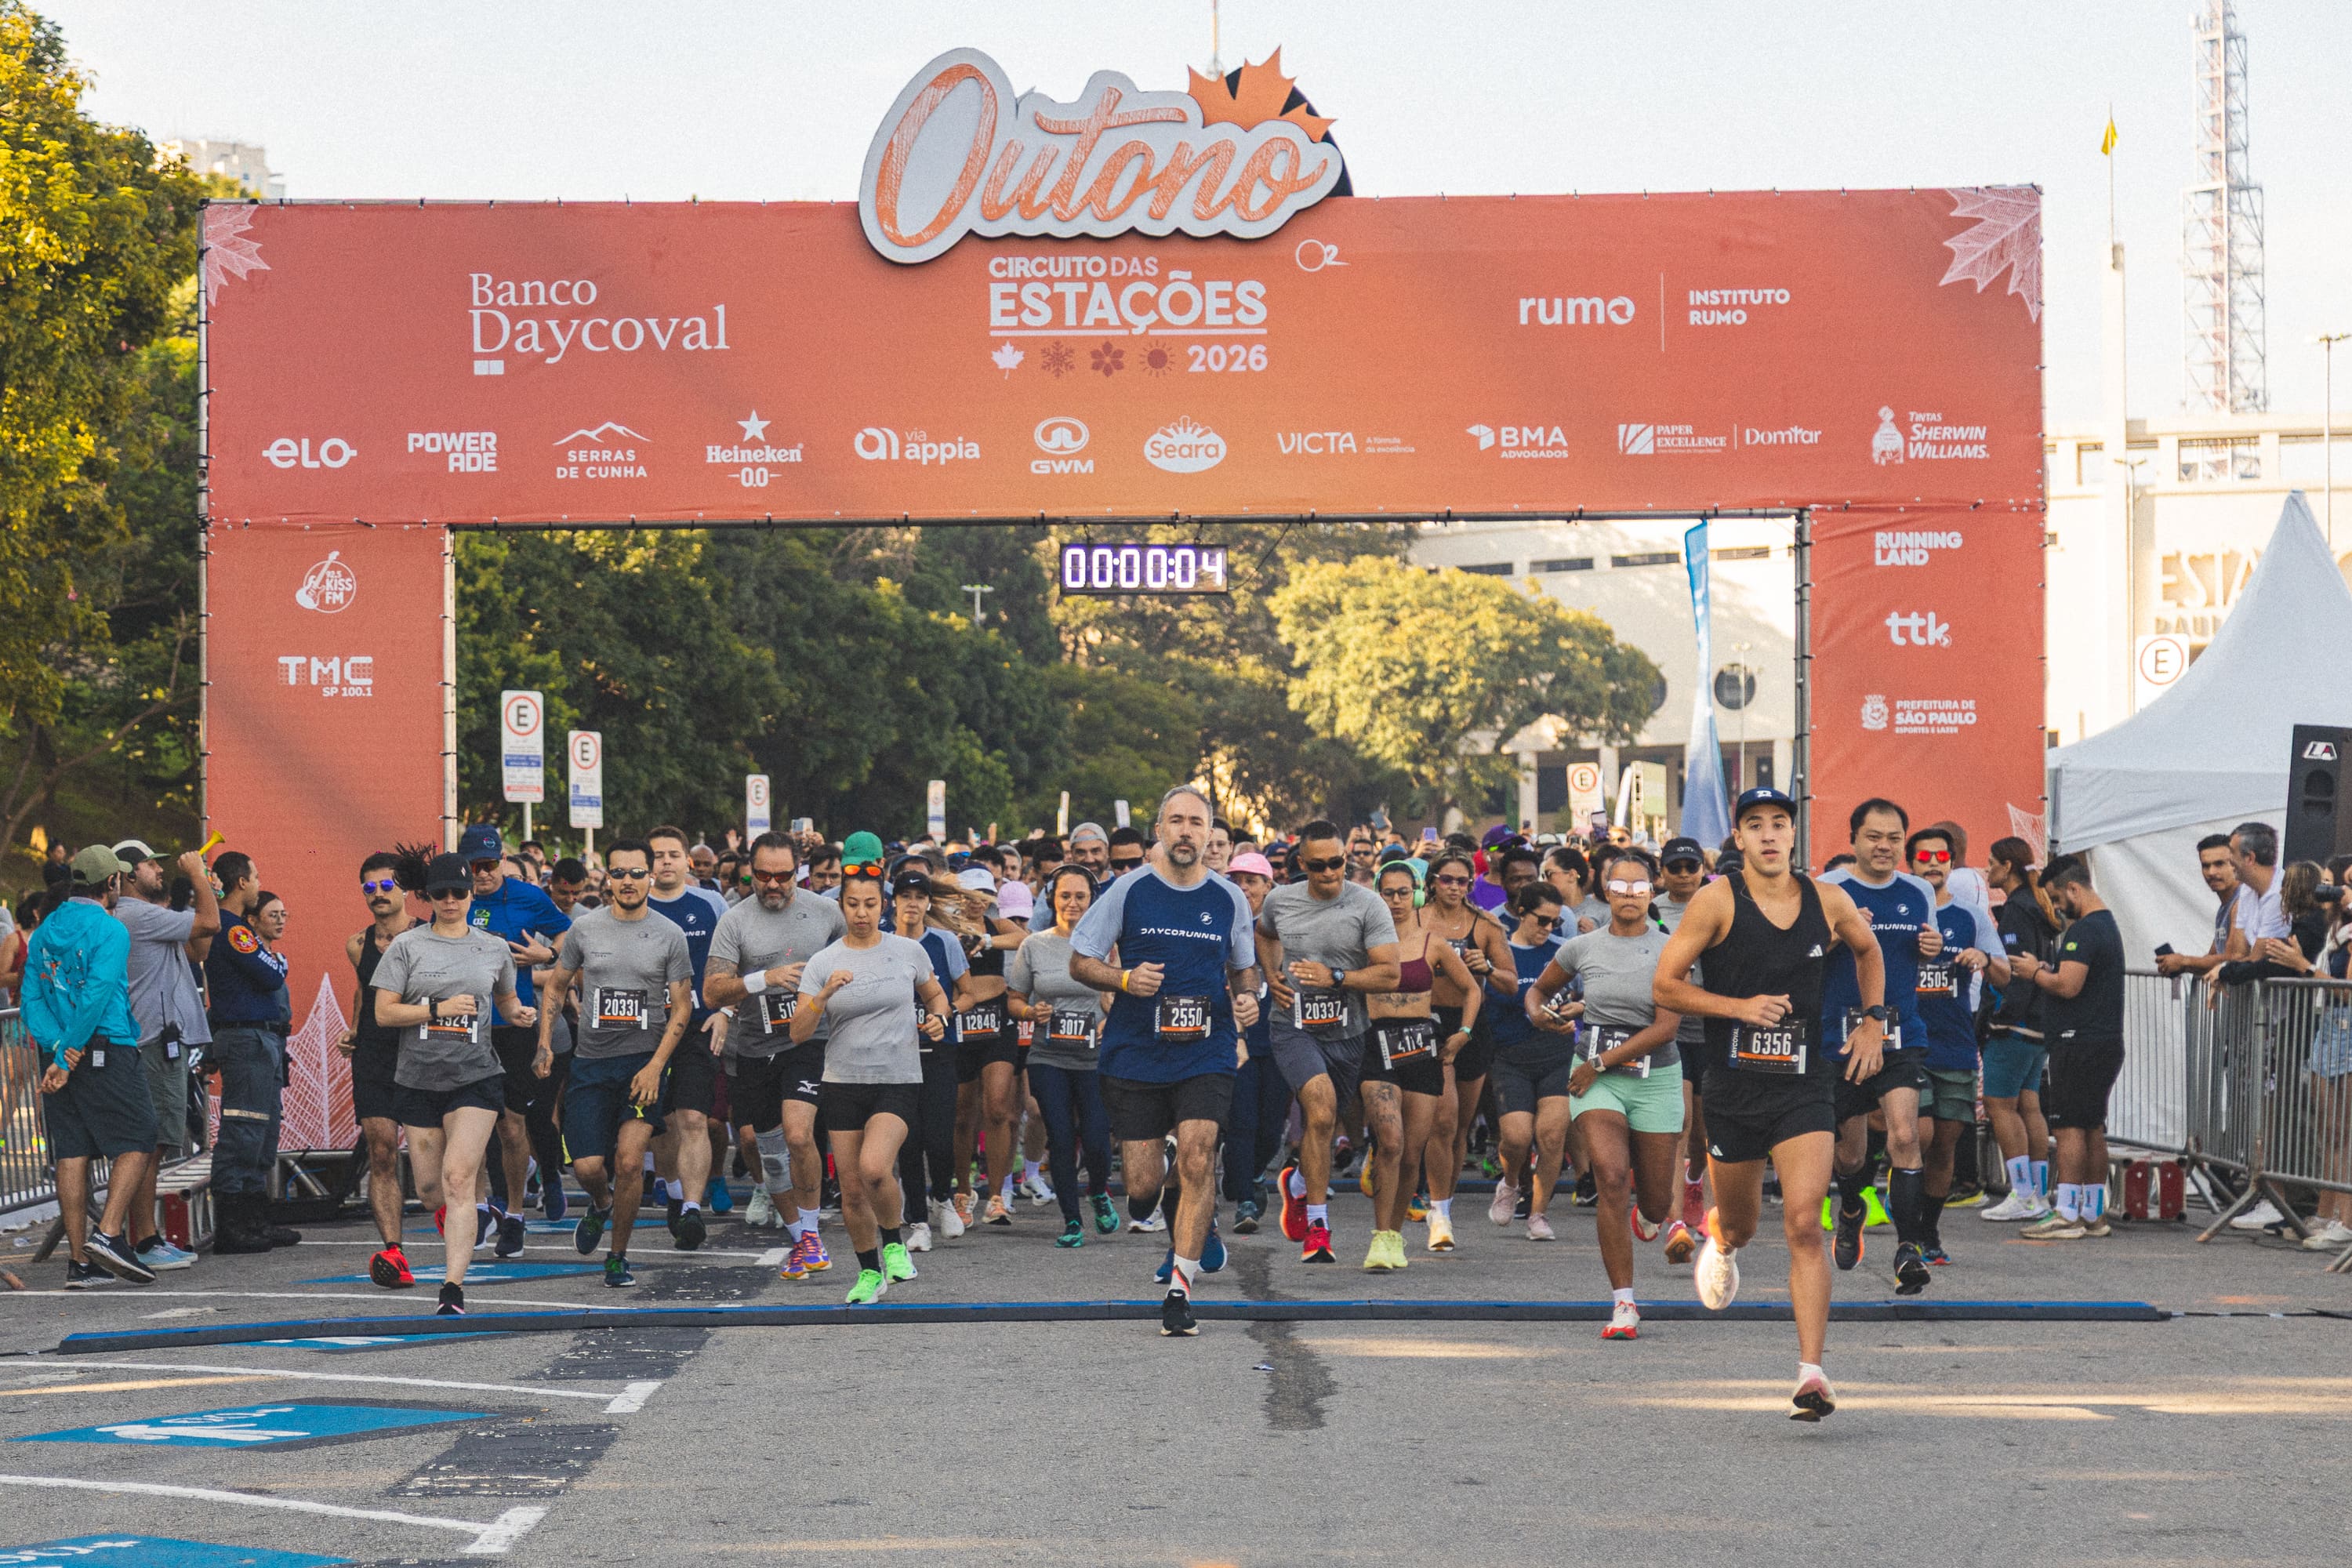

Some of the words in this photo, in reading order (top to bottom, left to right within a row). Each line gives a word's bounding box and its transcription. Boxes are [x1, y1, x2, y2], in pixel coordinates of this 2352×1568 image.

[875, 63, 1329, 248] Outono
[988, 256, 1107, 278] CIRCUITO
[1110, 256, 1159, 277] DAS
[468, 273, 597, 307] Banco
[1689, 288, 1791, 306] INSTITUTO
[989, 270, 1268, 335] ESTAÇÕES
[1519, 296, 1635, 325] rumo
[1689, 309, 1748, 325] RUMO
[468, 303, 731, 365] Daycoval
[1187, 343, 1269, 372] 2026
[906, 430, 927, 442] via
[1500, 426, 1569, 448] BMA
[1656, 424, 1693, 436] PAPER
[1744, 425, 1822, 445] Domtar
[1909, 423, 1987, 441] SHERWIN
[408, 431, 497, 453] POWER
[1149, 438, 1220, 460] Seara
[1276, 431, 1358, 454] VICTA
[1656, 436, 1726, 447] EXCELLENCE
[568, 449, 636, 463] SERRAS
[904, 438, 981, 466] appia
[1501, 449, 1569, 459] ADVOGADOS
[446, 452, 497, 473] ADE
[556, 466, 579, 479] DE
[586, 465, 648, 478] CUNHA
[1030, 459, 1094, 474] GWM
[1875, 531, 1963, 550] RUNNING
[1875, 548, 1929, 566] LAND
[1064, 547, 1224, 589] 00:00:04
[325, 578, 353, 592] KISS
[325, 591, 344, 604] FM
[1885, 611, 1947, 647] ttk
[278, 655, 373, 686] TMC
[2154, 648, 2170, 674] E
[321, 686, 339, 697] SP
[341, 686, 373, 697] 100.1
[1896, 699, 1960, 710] PREFEITURA
[1961, 699, 1976, 710] DE
[516, 705, 528, 727] E
[1895, 709, 1927, 725] SÃO
[1928, 711, 1977, 725] PAULO
[1894, 726, 1929, 735] ESPORTES
[580, 742, 590, 762] E
[754, 784, 761, 800] E
[1141, 927, 1222, 942] DAYCORUNNER
[1920, 971, 1949, 988] 2505
[604, 998, 639, 1017] 20331
[778, 1000, 798, 1020] 516
[1171, 1007, 1203, 1028] 2550
[1305, 1000, 1341, 1020] 20337
[965, 1013, 996, 1030] 12848
[1059, 1018, 1086, 1036] 3017
[1731, 1027, 1740, 1058] DAYCOVAL
[1751, 1031, 1792, 1056] 6356
